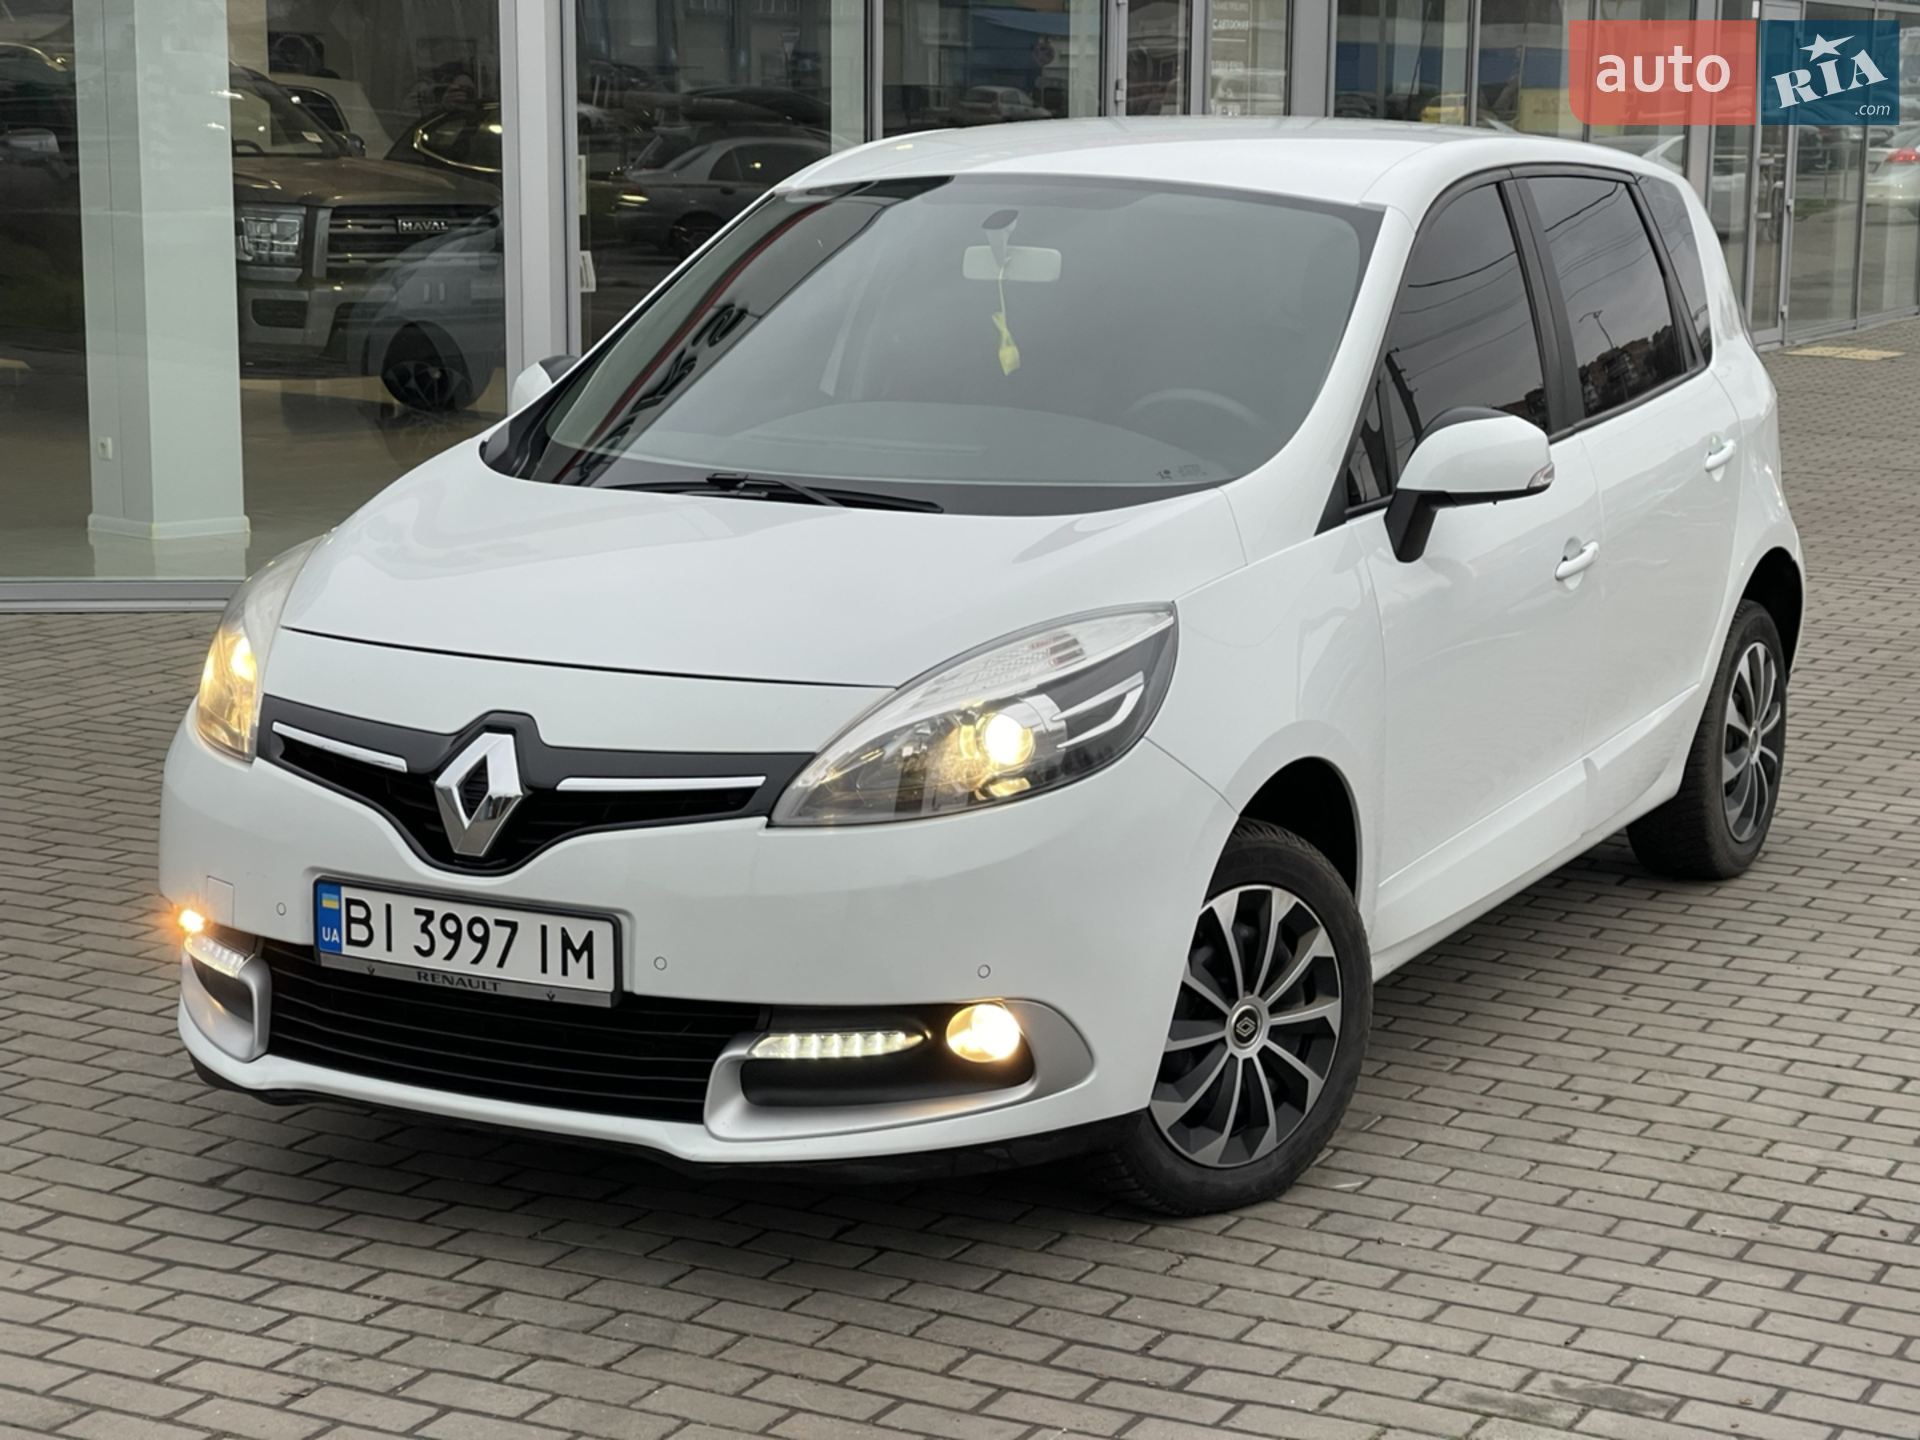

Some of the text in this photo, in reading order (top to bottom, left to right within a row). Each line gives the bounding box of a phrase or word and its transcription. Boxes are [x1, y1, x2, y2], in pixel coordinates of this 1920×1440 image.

[402, 221, 449, 231] HAVAL
[321, 926, 340, 944] UA
[344, 897, 595, 980] BI 3997 IM
[417, 970, 501, 993] RENAULT
